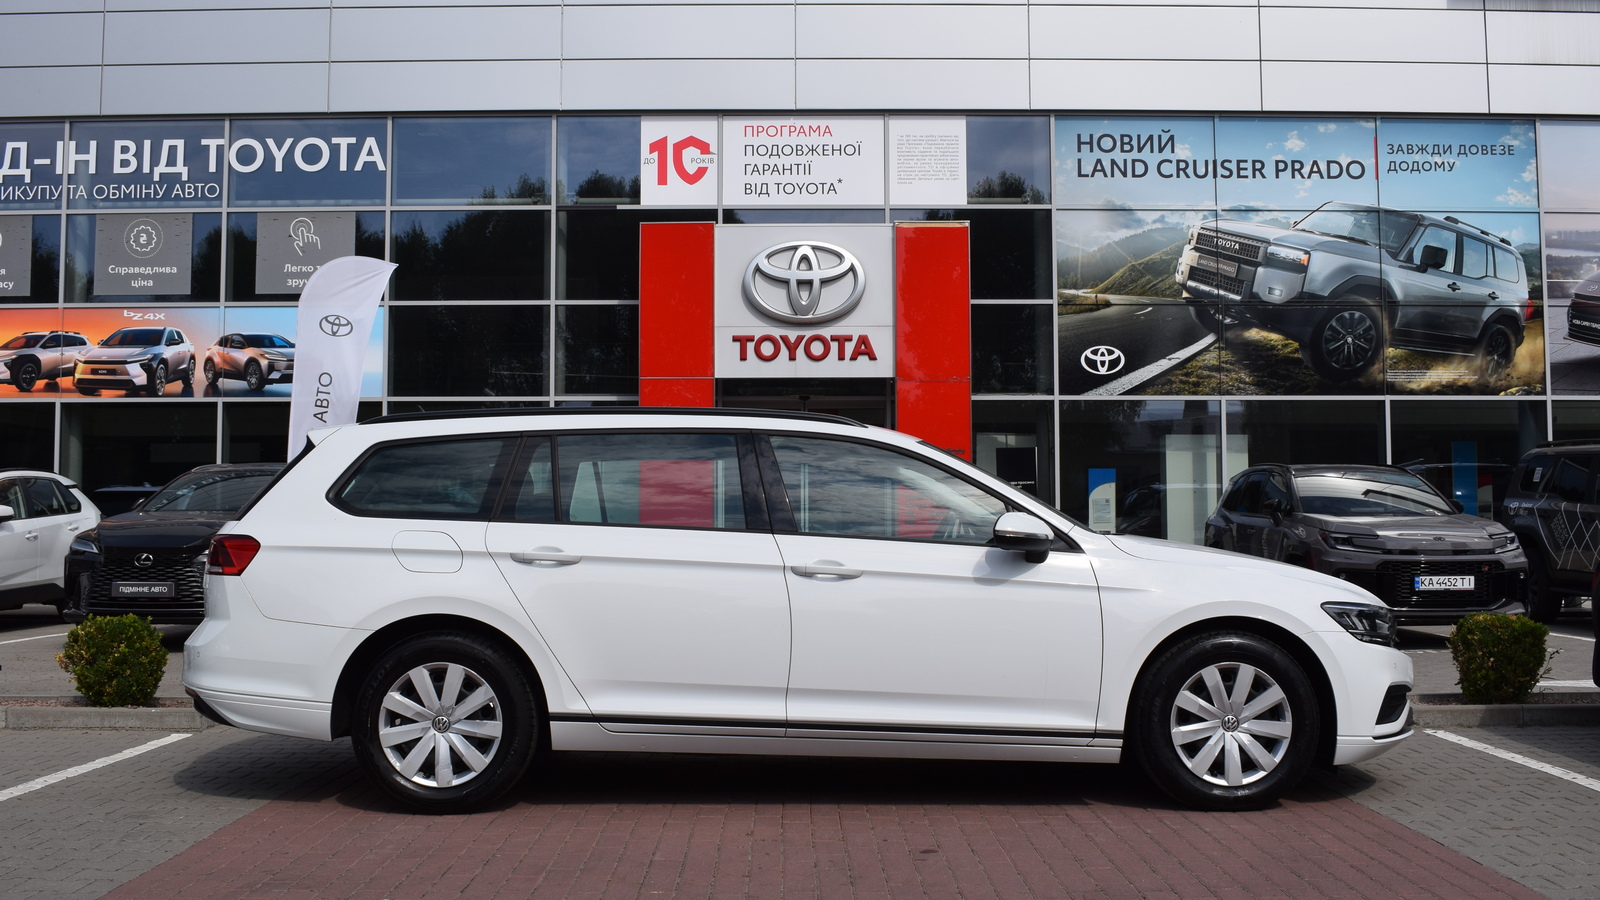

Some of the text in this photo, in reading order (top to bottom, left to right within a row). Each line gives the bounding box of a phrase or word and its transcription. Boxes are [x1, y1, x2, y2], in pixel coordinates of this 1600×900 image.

[744, 124, 833, 138] ПРОГРАМА
[744, 140, 863, 158] ПОДОВЖЕНОЇ
[1076, 129, 1175, 155] НОВИЙ
[1386, 143, 1515, 158] ЗАВЖДИ ДОВЕЗЕ
[113, 139, 189, 181] ВІД
[201, 137, 386, 173] TOYOTA
[643, 157, 656, 166] ДО
[690, 157, 715, 165] РОКІВ
[744, 162, 812, 176] ГАРАНТІЇ
[1077, 158, 1367, 181] LAND CRUISER PRADO
[1387, 160, 1456, 174] ДОДОМУ
[66, 185, 87, 199] ТА
[93, 184, 168, 199] ОБМІНУ
[171, 183, 220, 198] АВТО
[744, 182, 770, 197] ВІД
[1213, 237, 1240, 250] TOYOTA
[108, 264, 178, 276] Справедлива
[283, 263, 314, 273] Легко
[131, 276, 154, 288] ціна
[732, 333, 878, 362] TOYOTA
[313, 371, 333, 423] АВТО
[1420, 577, 1434, 587] KA
[1436, 577, 1458, 587] 4452
